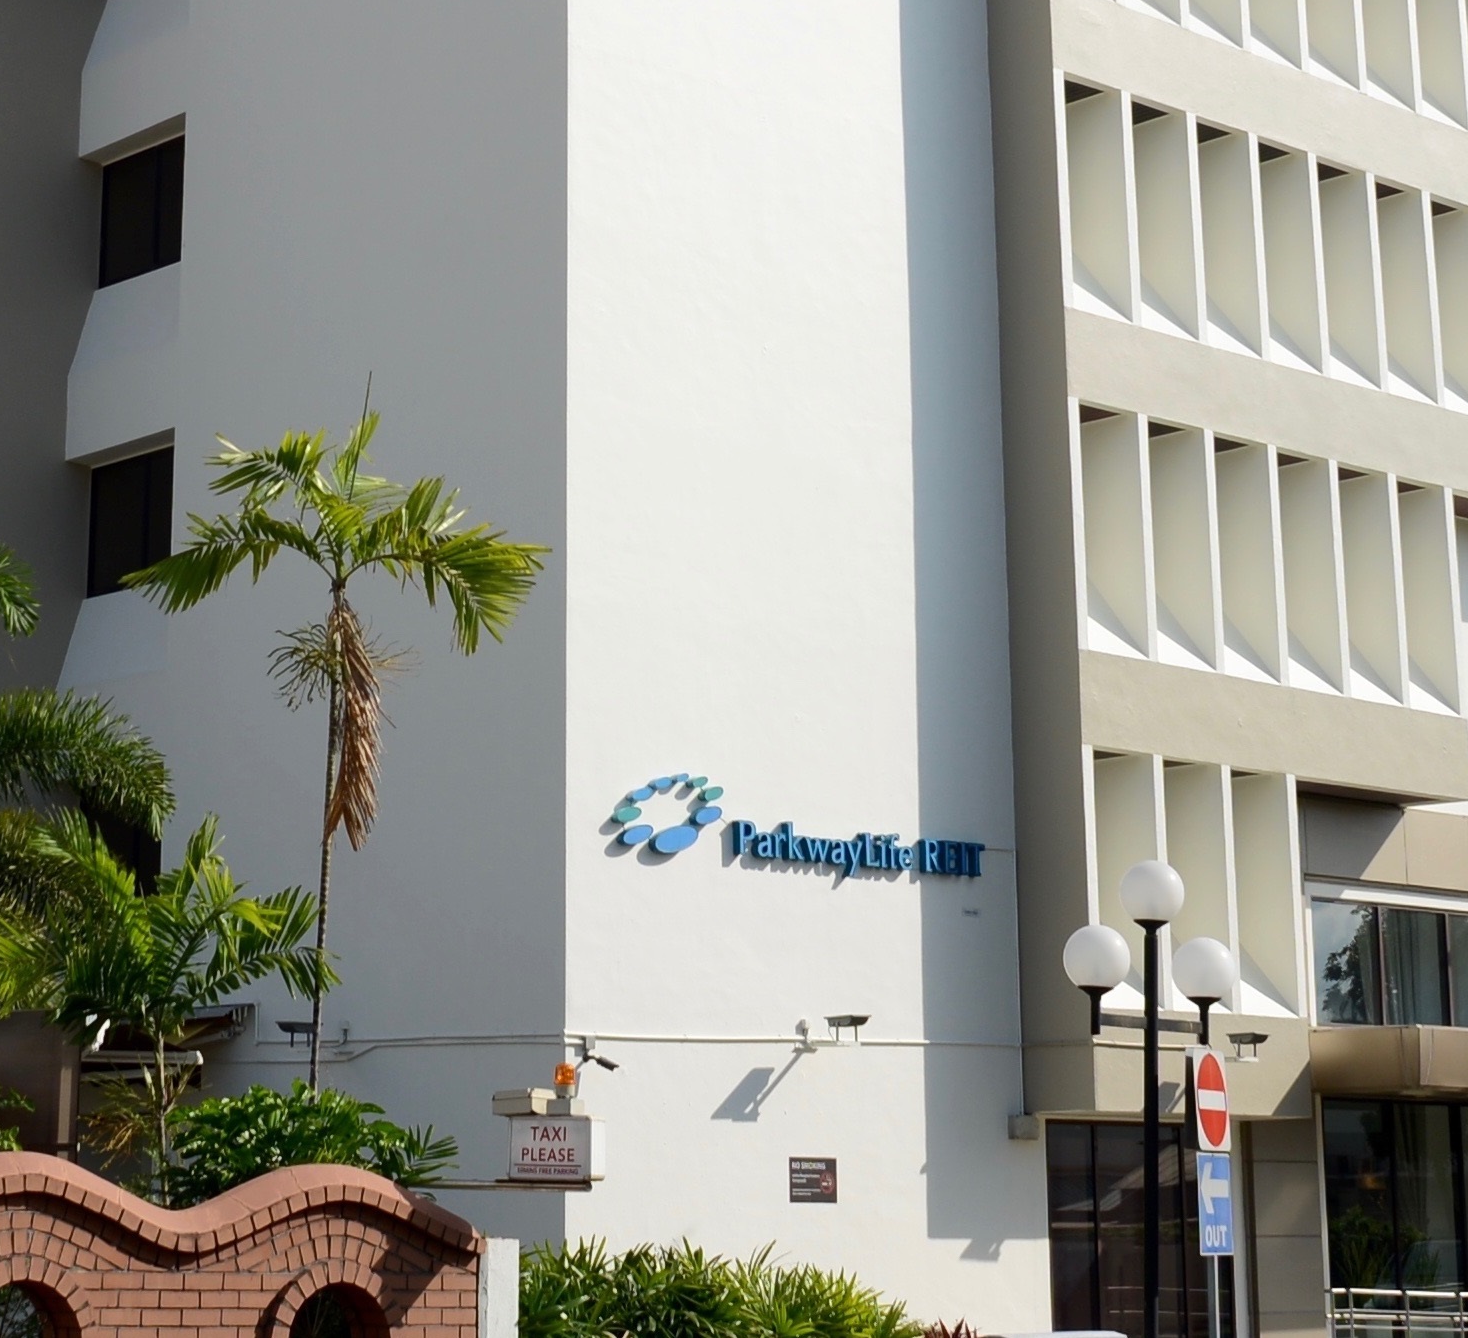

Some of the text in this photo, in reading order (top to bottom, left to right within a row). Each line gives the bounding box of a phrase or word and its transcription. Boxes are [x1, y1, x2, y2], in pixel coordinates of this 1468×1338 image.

[732, 820, 985, 878] ParkwayLife REIT
[531, 1126, 566, 1141] TAXI
[521, 1148, 575, 1162] PLEASE
[1205, 1224, 1227, 1247] OUT
